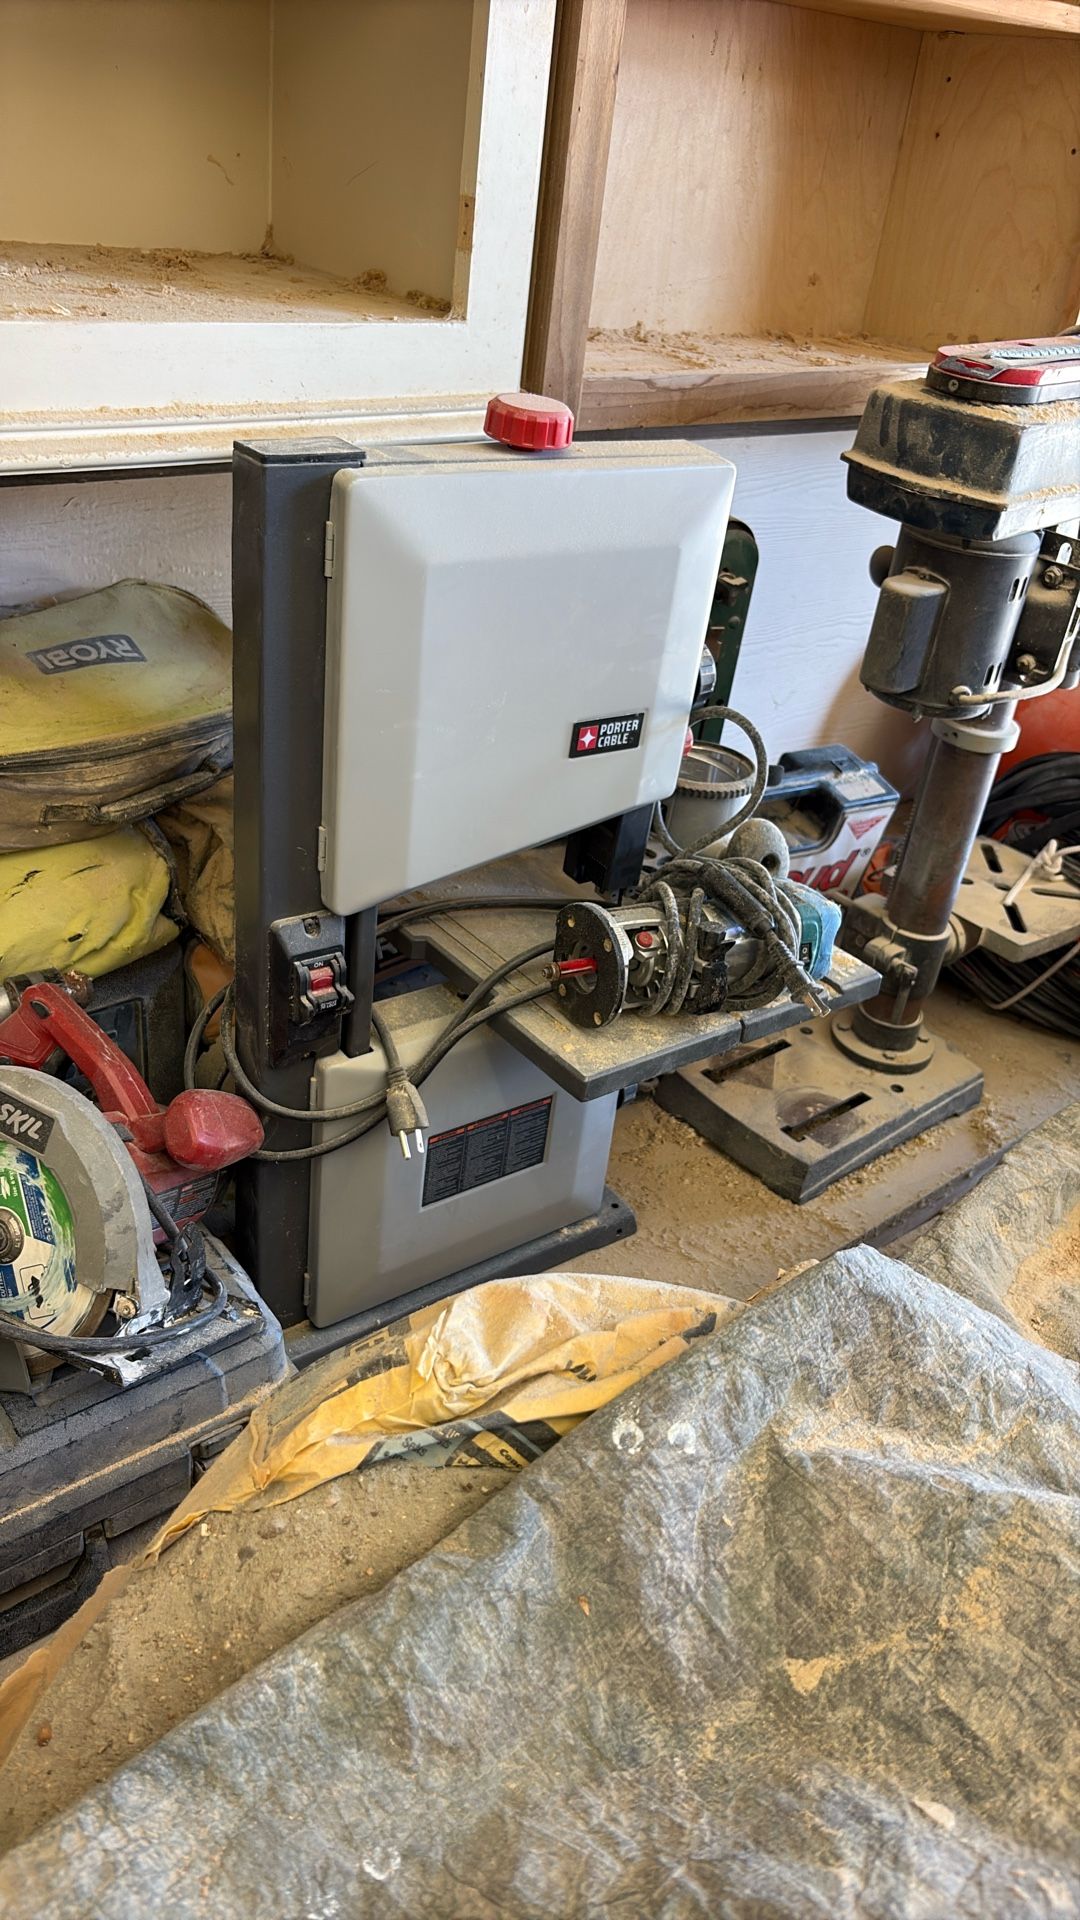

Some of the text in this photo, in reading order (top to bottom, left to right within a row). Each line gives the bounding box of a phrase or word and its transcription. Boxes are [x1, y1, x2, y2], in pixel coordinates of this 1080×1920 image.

[38, 639, 139, 669] RYOBI
[600, 720, 640, 735] PORTER
[598, 733, 629, 747] CABLE
[0, 1103, 43, 1140] SKIL
